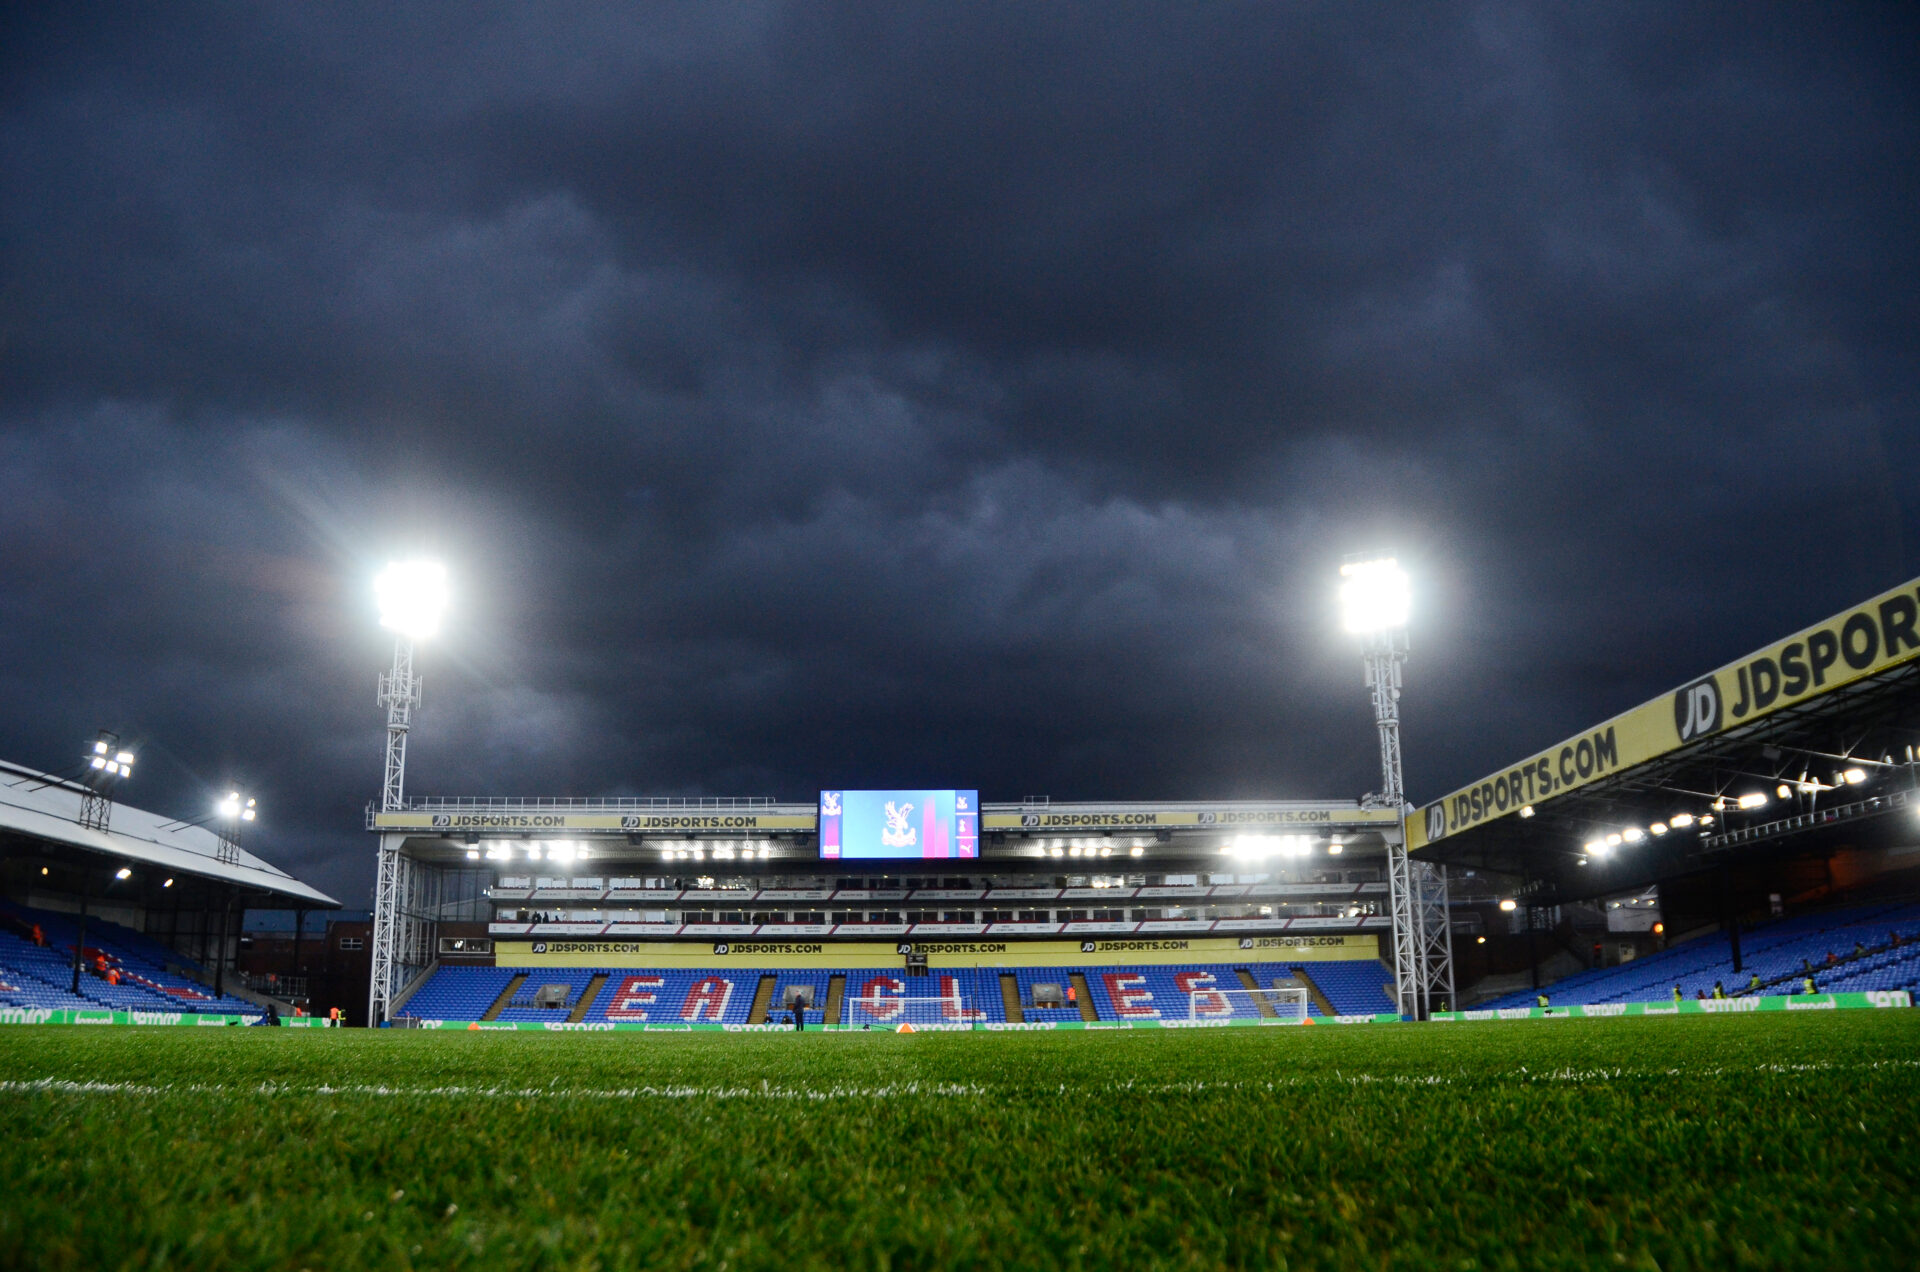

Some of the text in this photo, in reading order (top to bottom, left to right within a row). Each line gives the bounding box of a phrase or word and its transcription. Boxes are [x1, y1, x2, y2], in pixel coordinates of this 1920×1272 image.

[1682, 587, 1920, 741] JD JDSPOR
[1427, 726, 1619, 838] JD JDSPORTS.COM
[454, 816, 565, 826] JDSPORTS.COM
[643, 816, 757, 828] JDSPORTS.COM
[1044, 814, 1157, 825] JDSPORTS.COM
[1220, 811, 1331, 823] JDSPORTS.COM
[550, 943, 640, 953] JDSPORTS.COM
[1098, 941, 1189, 951] JDSPORTS.COM
[1256, 937, 1345, 948] JDSPORTS.COM
[731, 944, 822, 954] JDSPORTS.COM
